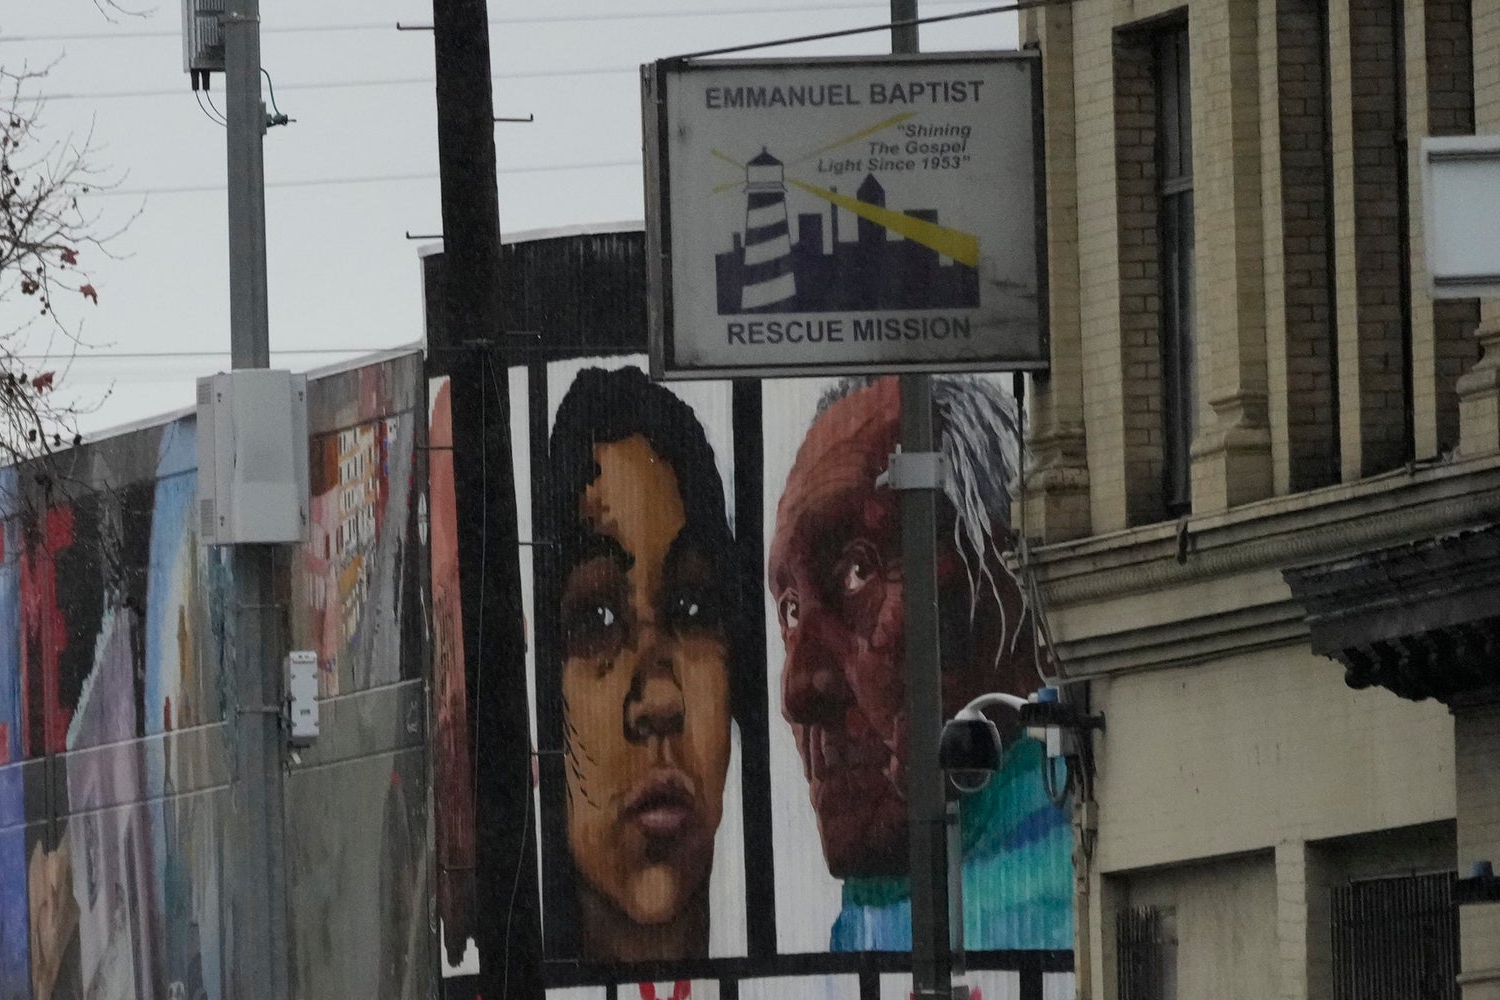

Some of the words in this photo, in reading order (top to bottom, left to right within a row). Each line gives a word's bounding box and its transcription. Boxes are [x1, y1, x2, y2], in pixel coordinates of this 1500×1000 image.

[705, 84, 860, 109] EMMANUEL
[869, 80, 984, 105] BAPTIST
[869, 141, 896, 156] The
[905, 138, 967, 156] Gospel
[818, 158, 862, 174] Light
[867, 157, 916, 172] Since
[727, 320, 844, 345] RESCUE
[853, 316, 972, 342] MISSION
